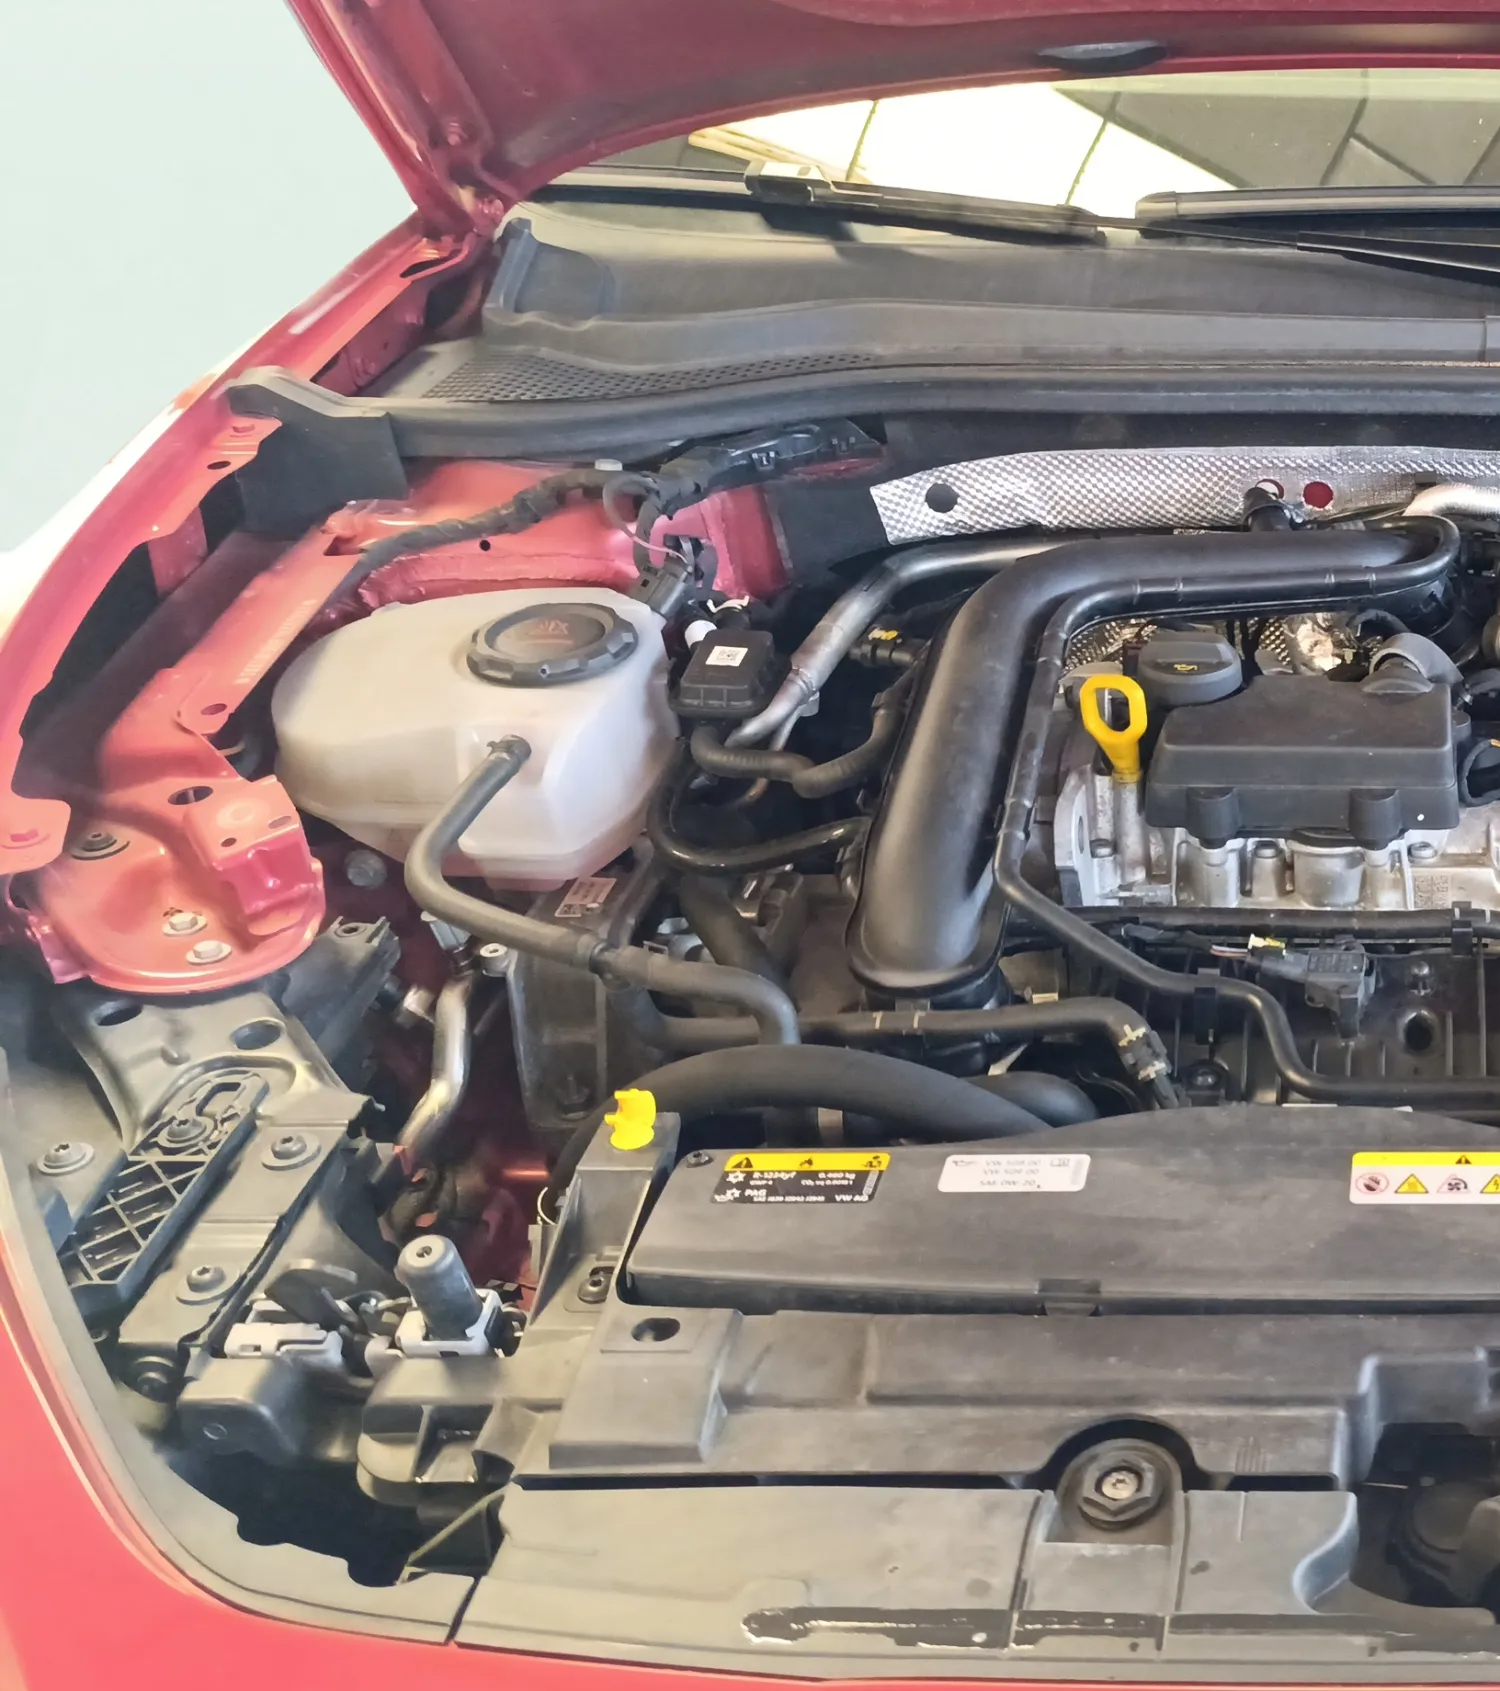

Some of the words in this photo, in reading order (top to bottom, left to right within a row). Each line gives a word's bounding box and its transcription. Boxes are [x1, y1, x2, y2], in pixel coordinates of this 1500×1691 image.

[744, 1189, 768, 1197] PAG
[834, 1194, 853, 1202] VW
[853, 1194, 869, 1202] AG
